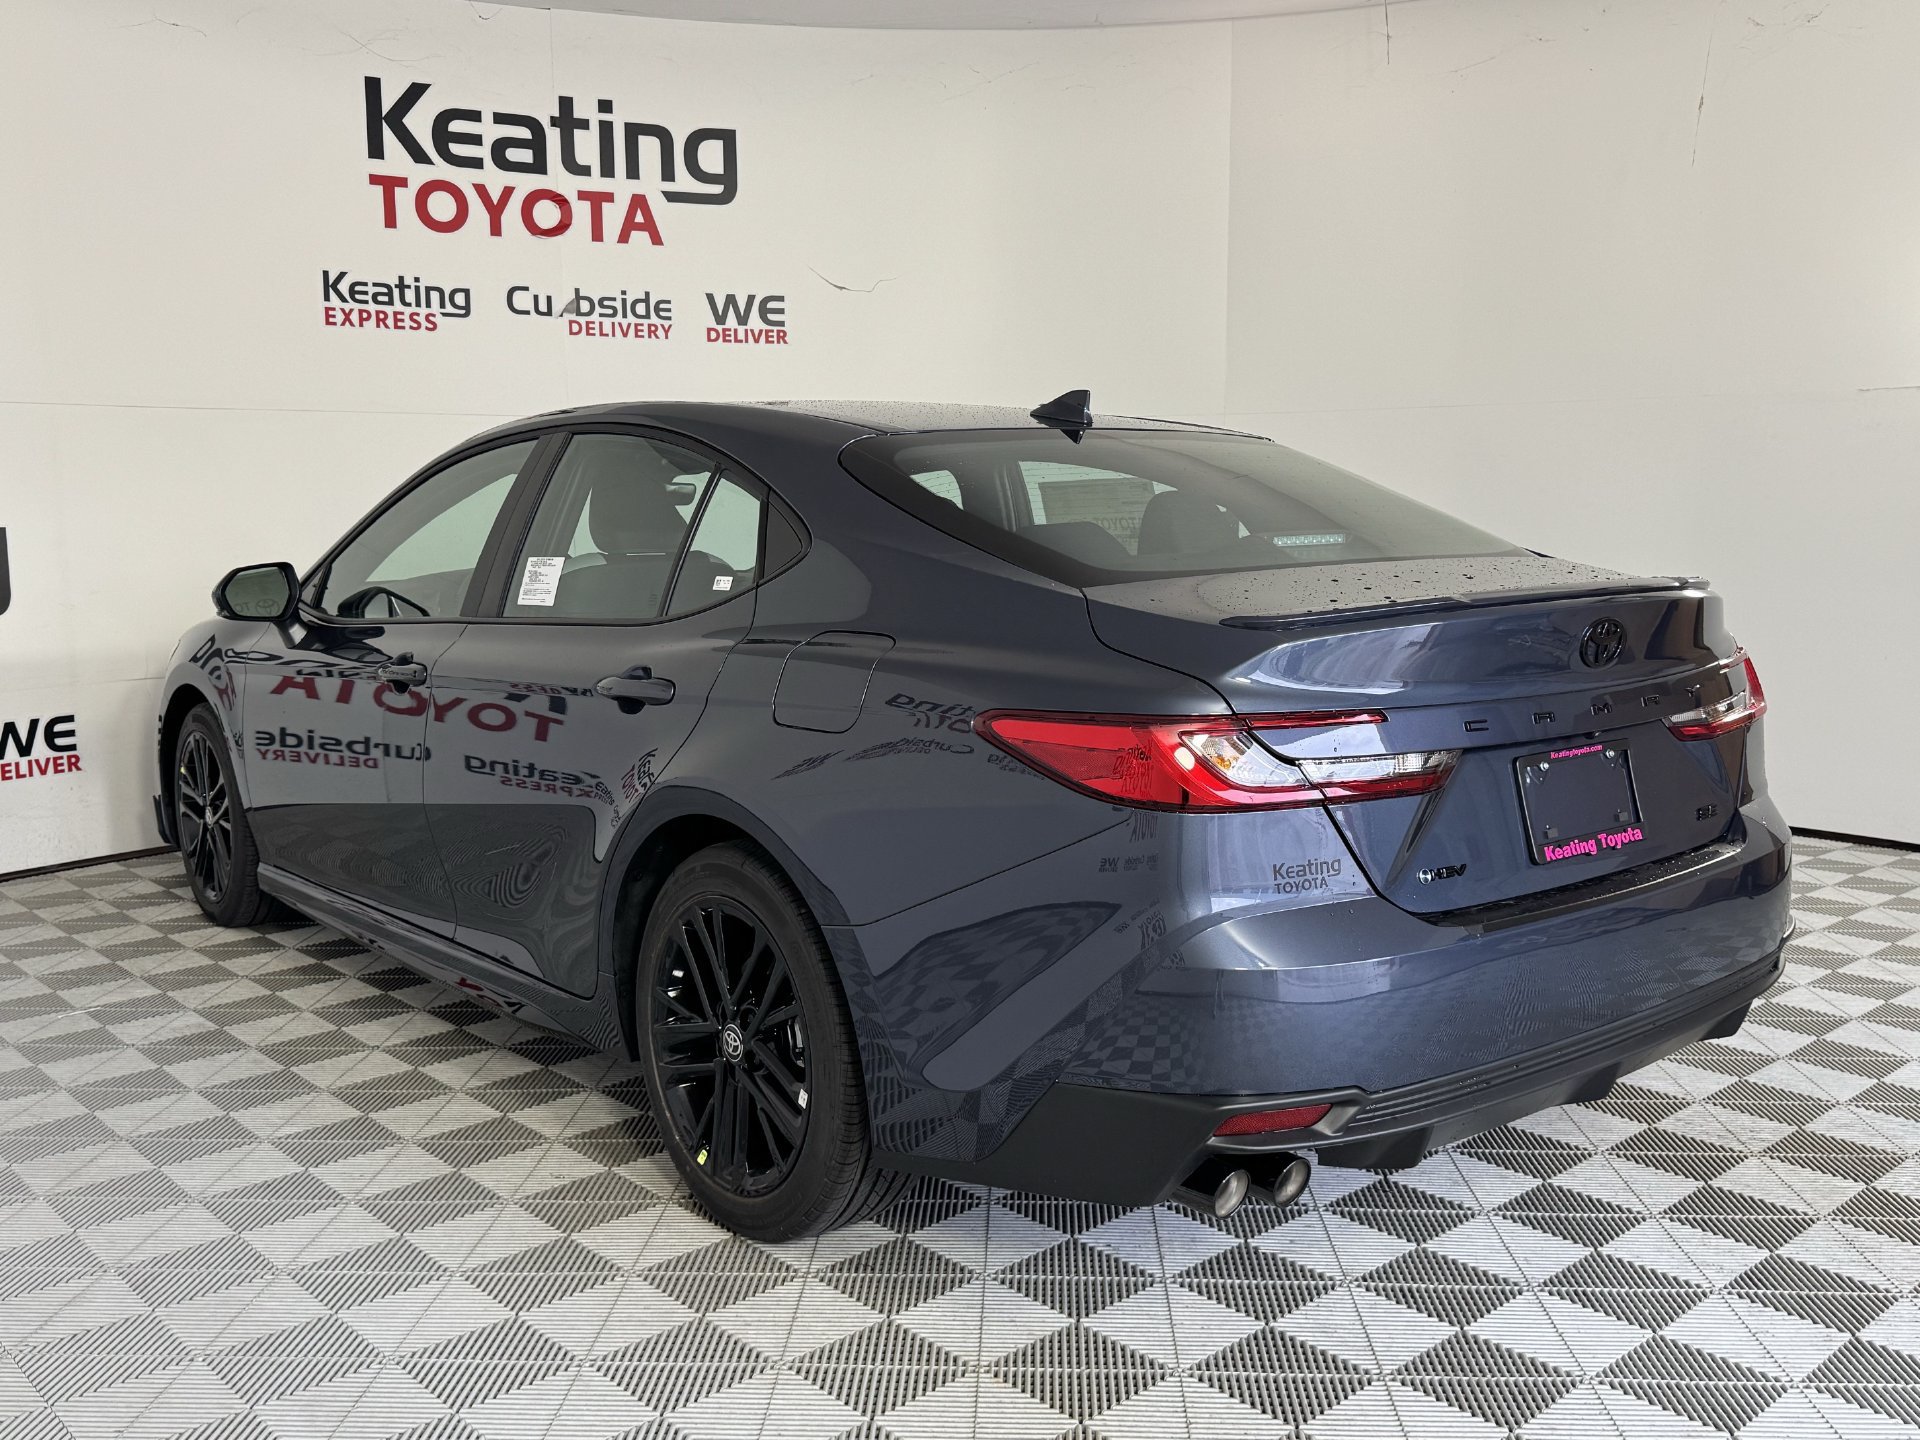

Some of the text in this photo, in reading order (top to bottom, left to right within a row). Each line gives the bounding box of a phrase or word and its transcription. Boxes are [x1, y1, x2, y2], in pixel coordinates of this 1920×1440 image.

[365, 76, 738, 205] Keating
[368, 174, 664, 247] TOYOTA
[322, 269, 471, 318] Keating
[506, 285, 672, 321] Cubside
[706, 292, 786, 327] WE
[324, 305, 438, 332] EXPRESS
[568, 319, 672, 340] DELIVERY
[706, 327, 788, 345] DELIVER
[1463, 684, 1701, 733] CAMRY
[0, 754, 82, 781] ELIVER
[1543, 827, 1643, 862] Keating Toyota
[1272, 858, 1342, 882] Keating
[1274, 877, 1329, 894] TOYOTA
